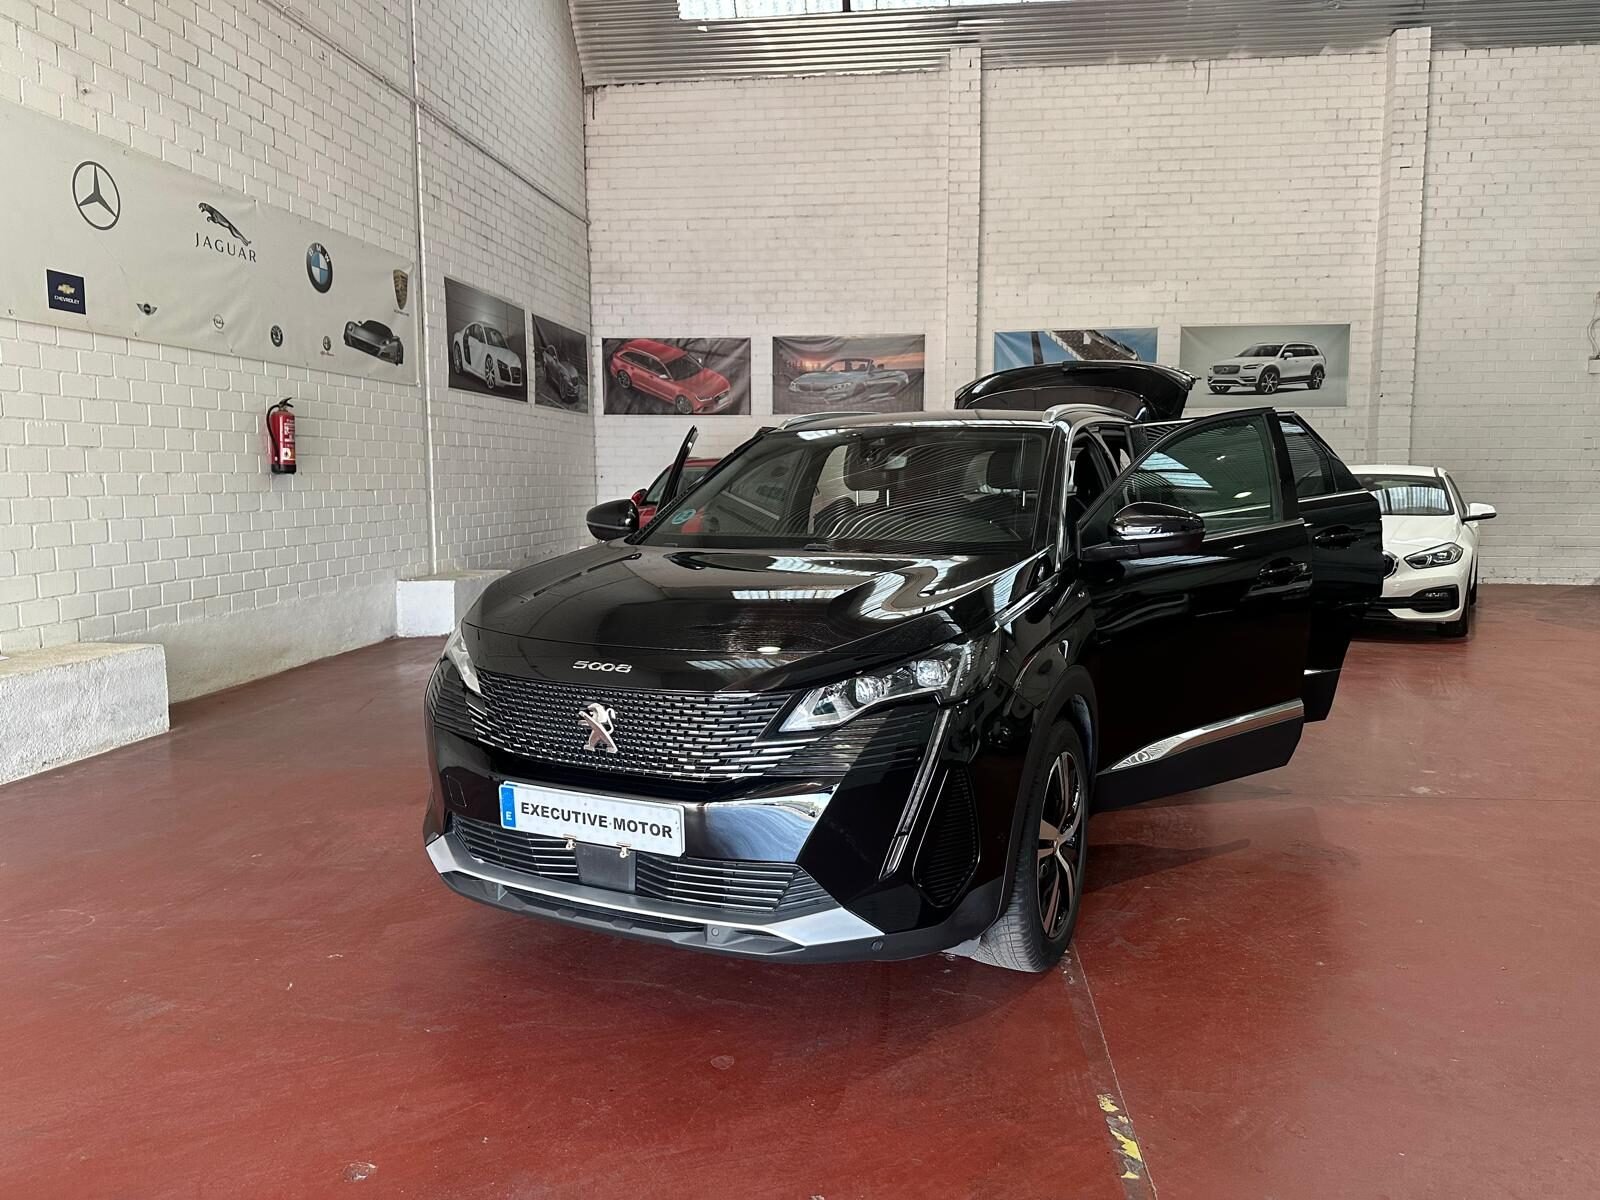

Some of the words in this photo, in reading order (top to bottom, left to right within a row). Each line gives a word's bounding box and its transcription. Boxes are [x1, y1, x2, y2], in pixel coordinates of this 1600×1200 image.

[195, 232, 256, 262] JAGUAR
[308, 244, 330, 262] BMW
[572, 660, 632, 673] 5008
[505, 811, 513, 821] E
[520, 801, 608, 828] EXECUTIVE
[612, 816, 673, 839] MOTOR
